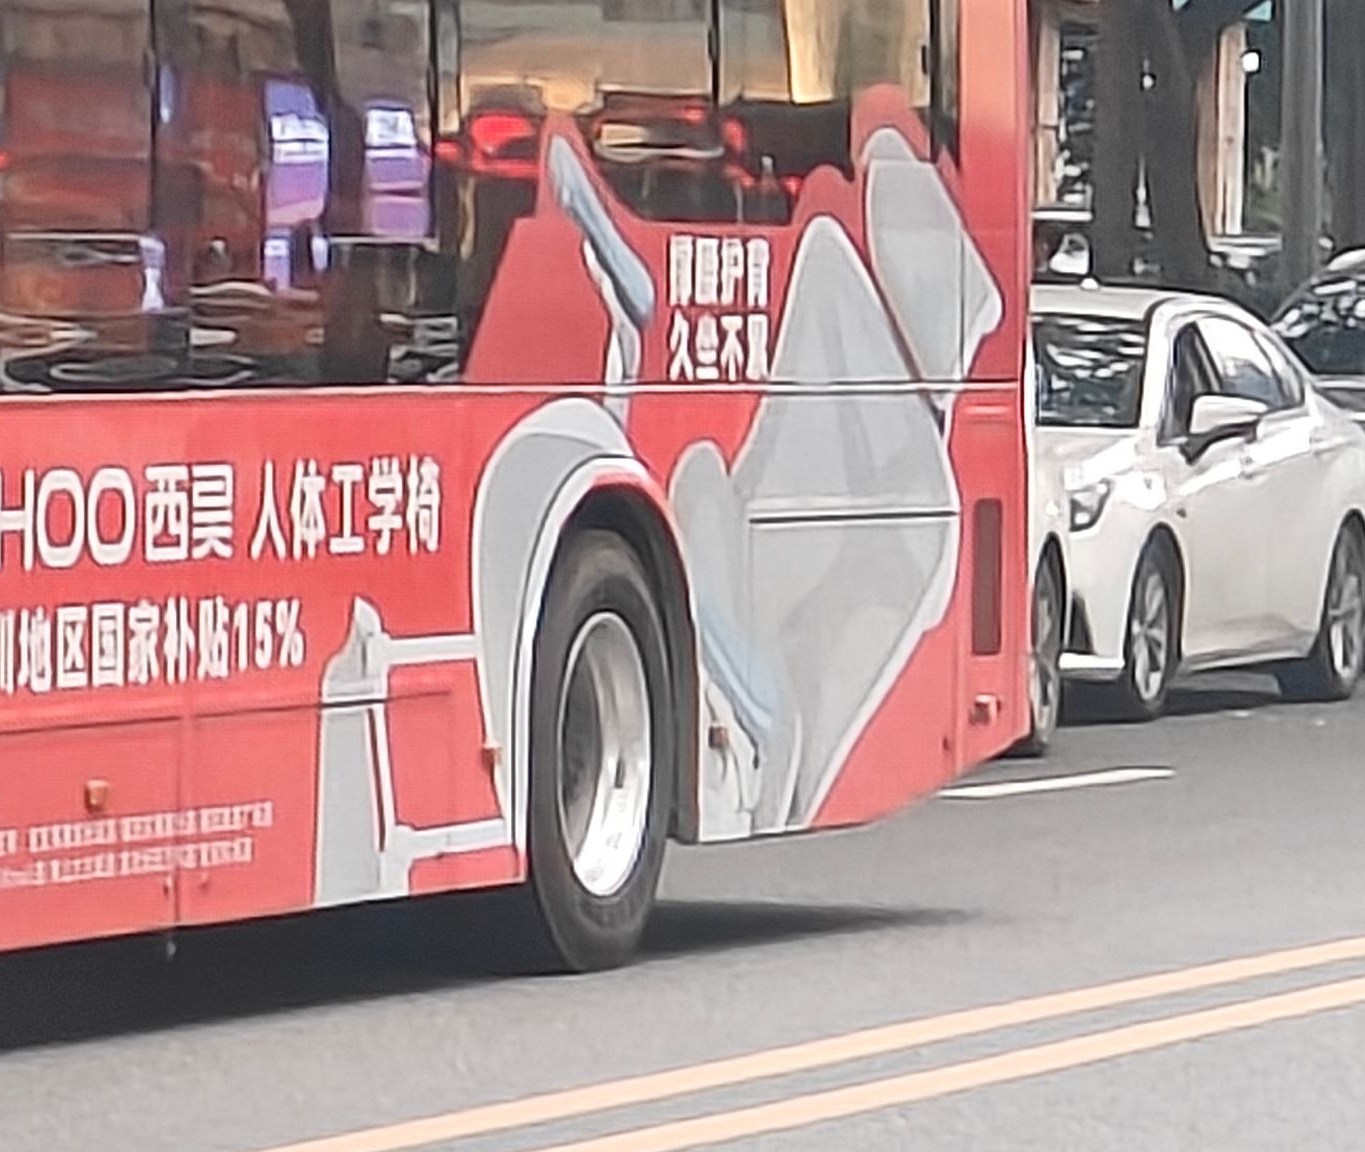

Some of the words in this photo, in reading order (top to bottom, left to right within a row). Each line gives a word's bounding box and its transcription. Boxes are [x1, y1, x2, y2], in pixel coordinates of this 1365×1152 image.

[250, 454, 441, 561] 人体工学椅
